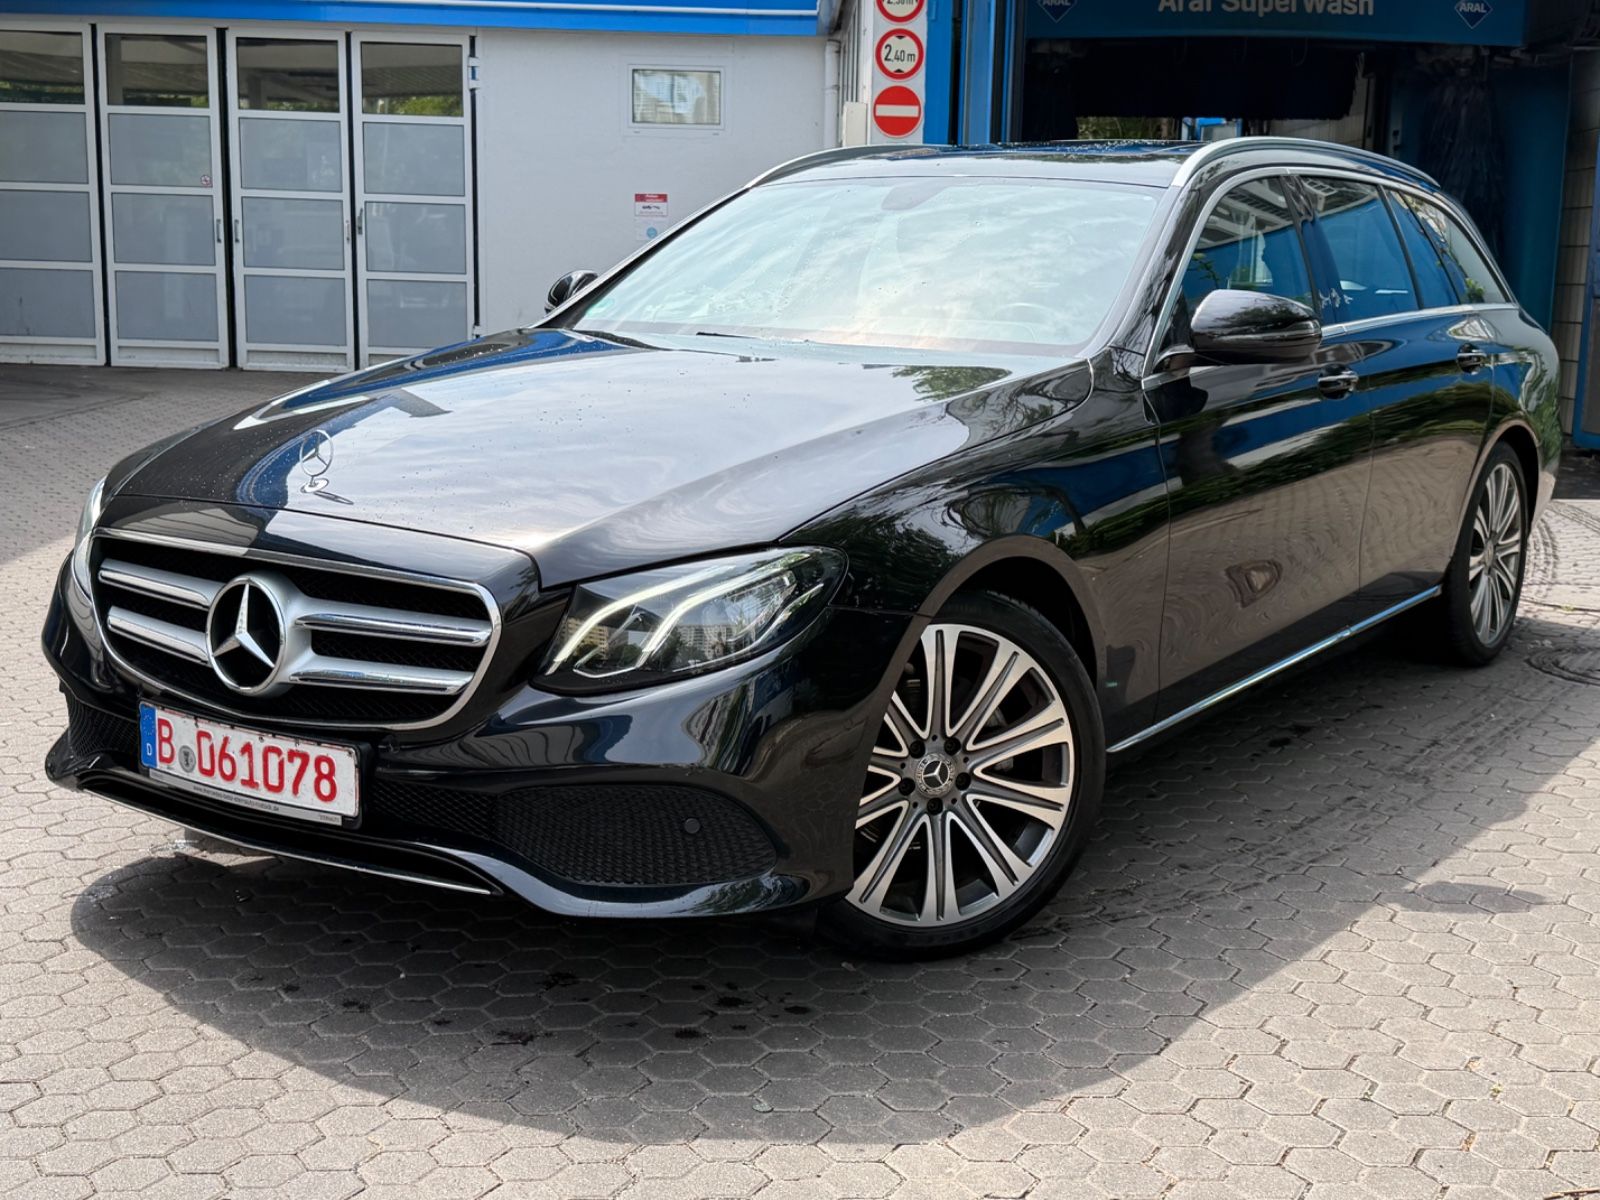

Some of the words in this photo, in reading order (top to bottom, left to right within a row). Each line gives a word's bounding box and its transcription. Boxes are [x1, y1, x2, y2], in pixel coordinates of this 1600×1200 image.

[1158, 0, 1212, 13] Aral
[1458, 2, 1487, 13] ARAL
[907, 53, 916, 62] m
[146, 743, 153, 756] D
[158, 718, 175, 764] B
[196, 730, 337, 802] 061078
